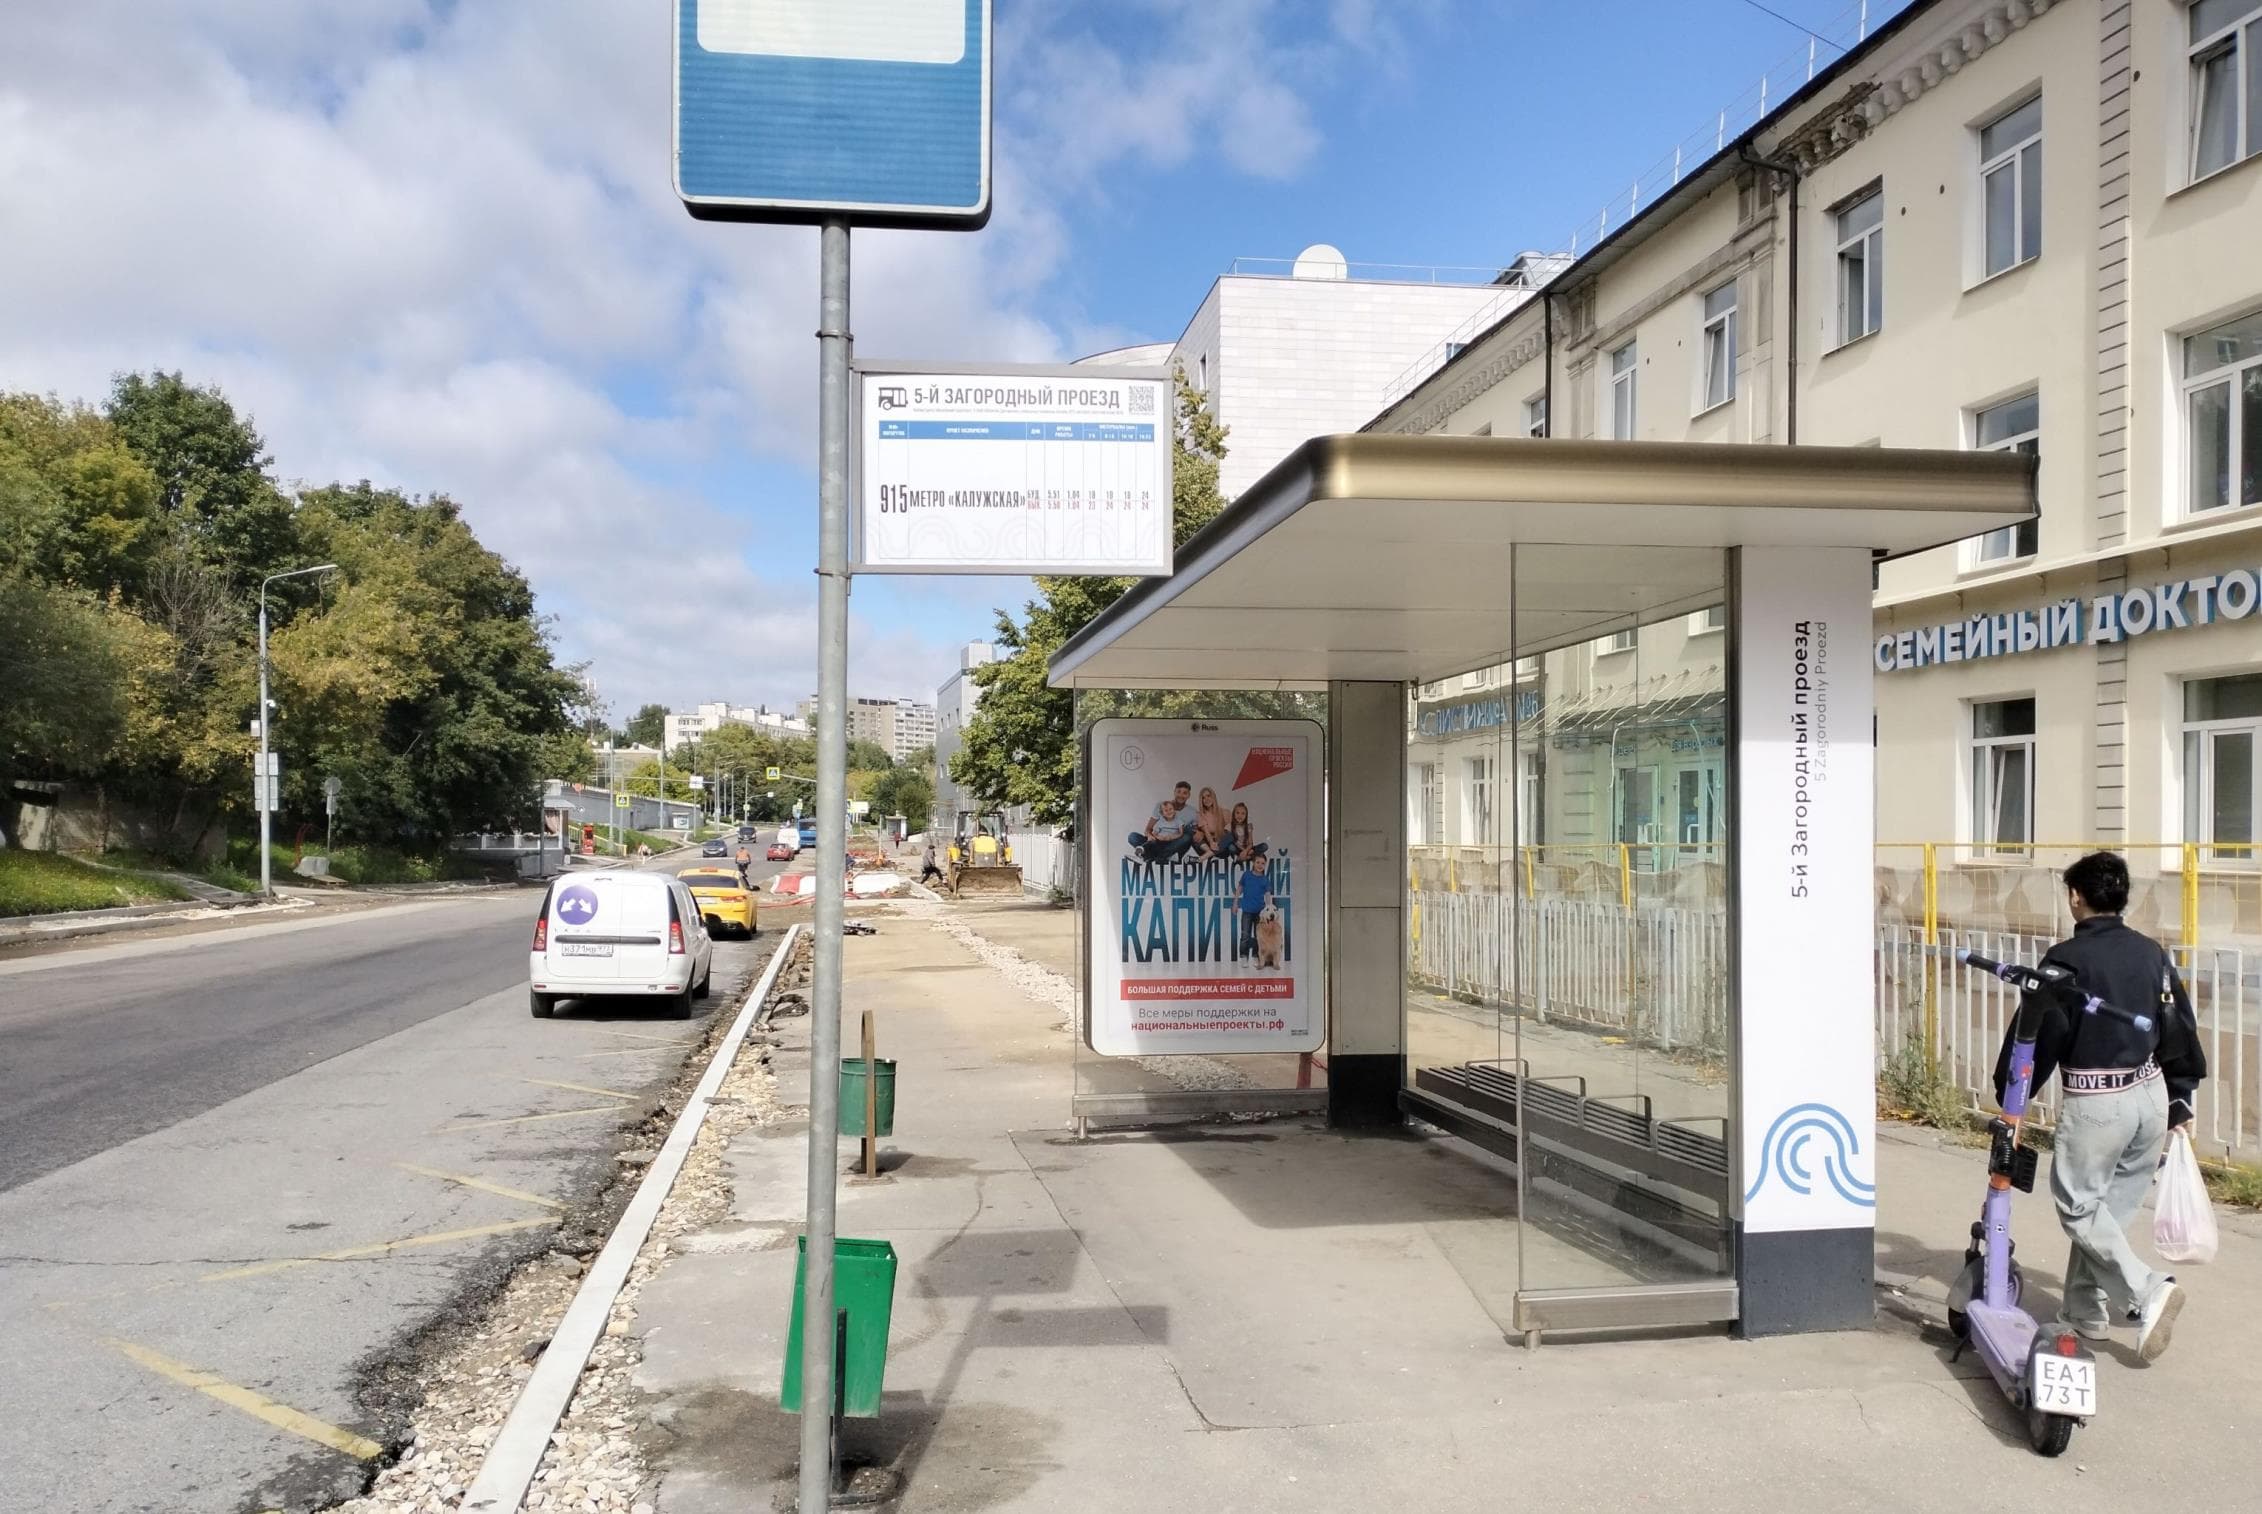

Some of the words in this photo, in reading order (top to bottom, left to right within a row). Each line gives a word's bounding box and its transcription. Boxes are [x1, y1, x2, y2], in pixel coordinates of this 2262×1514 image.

[914, 384, 939, 404] 5-Й
[945, 385, 1052, 407] ЗАГОРОДНЫЙ
[1058, 389, 1120, 408] ПРОЕЗД
[880, 484, 908, 513] 915
[909, 490, 945, 507] МЕТРО
[948, 490, 1026, 508] «КАЛУЖСКАЯ»
[1875, 600, 2080, 672] СЕМЕЙНЫЙ
[2089, 569, 2262, 646] ДОКТО
[1795, 621, 1811, 704] проезд
[1814, 622, 1827, 674] Proezd
[1814, 679, 1829, 768] Zagorodniy
[1124, 750, 1141, 766] 0+
[1791, 713, 1812, 857] Загородный
[1814, 772, 1827, 782] 5
[1121, 848, 1291, 896] МАТЕРИНСИЙ
[1791, 864, 1808, 898] 5-й
[1121, 898, 1291, 962] КАПИТЛ
[1127, 985, 1166, 994] БОЛЬШАЯ
[1168, 985, 1218, 995] ПОДДЕРЖКА
[1221, 983, 1246, 993] СЕМЕЙ
[1247, 984, 1253, 992] С
[1254, 984, 1288, 994] ДЕТЬМИ
[1131, 1019, 1285, 1033] национальныепроекты.рф
[1138, 1008, 1159, 1018] Все
[1162, 1009, 1193, 1020] меры
[1196, 1008, 1261, 1019] поддержки
[1263, 1008, 1277, 1017] на
[2068, 1073, 2107, 1089] MOVE
[2112, 1074, 2126, 1087] IT
[2132, 1051, 2156, 1081] LOSE
